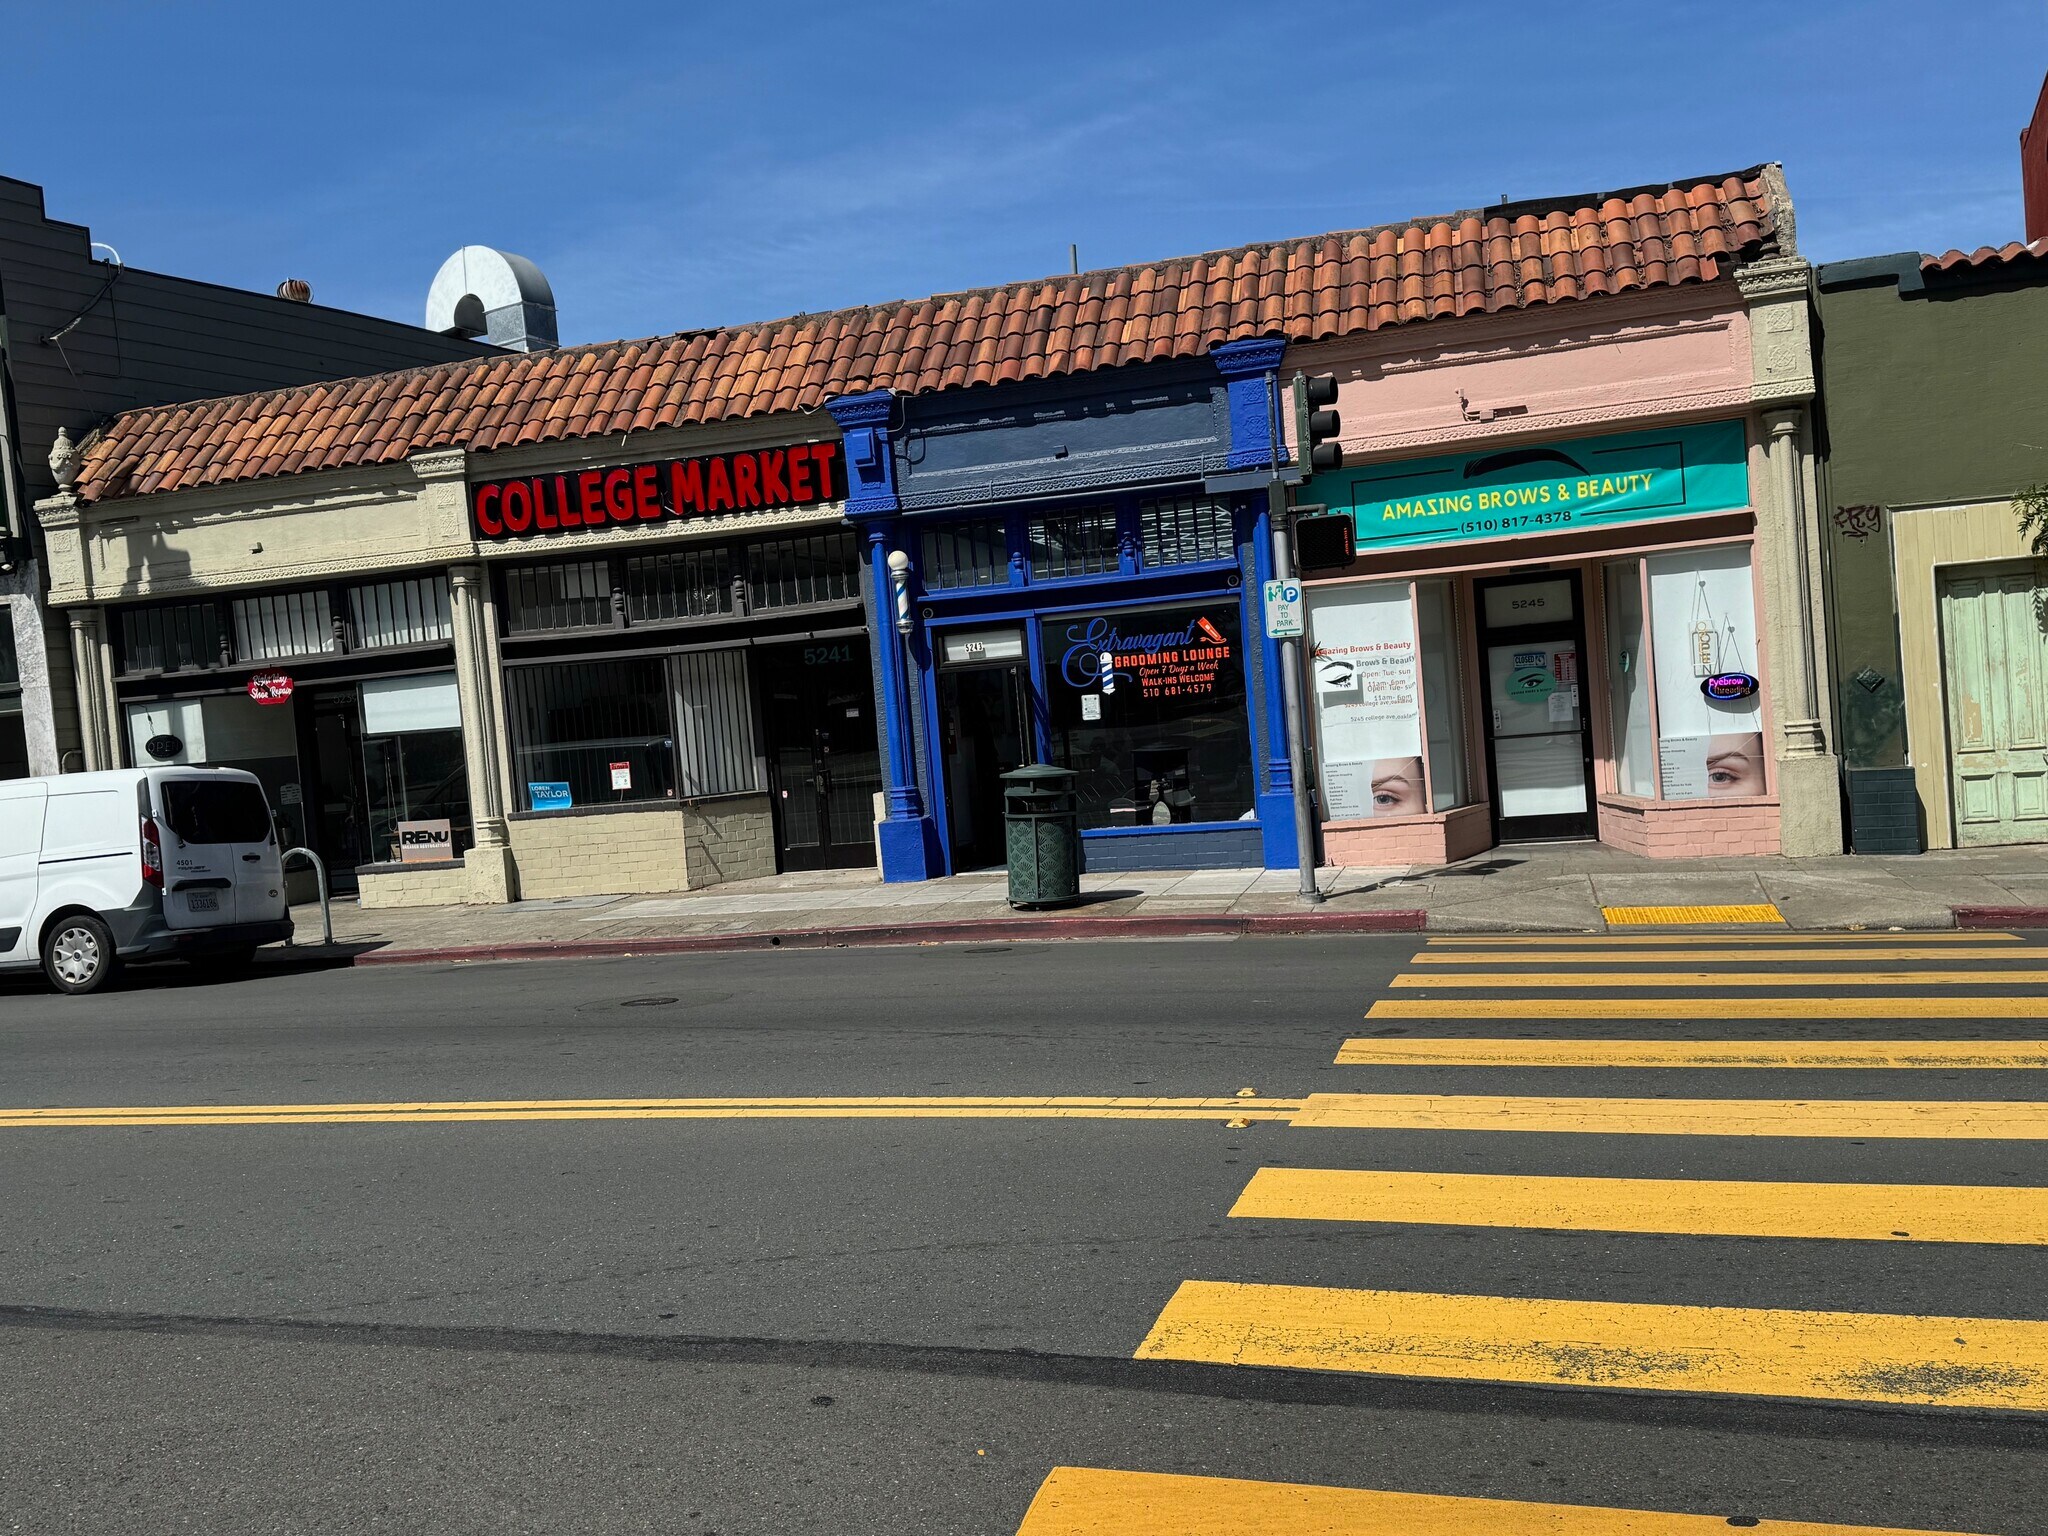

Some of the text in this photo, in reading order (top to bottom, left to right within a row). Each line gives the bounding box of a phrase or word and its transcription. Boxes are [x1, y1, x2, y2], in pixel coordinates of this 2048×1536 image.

[476, 443, 836, 535] COLLEGE MARKET
[1479, 485, 1551, 511] BROWS
[1557, 483, 1571, 501] &
[1577, 473, 1653, 499] BEAUTY
[1461, 510, 1572, 535] (510) 817-4378
[1277, 603, 1290, 612] PAY
[1512, 598, 1545, 610] 5245
[1276, 618, 1293, 627] PARK
[965, 642, 983, 652] 5243
[1061, 617, 1196, 688] Extravagant
[1350, 644, 1374, 653] Brows
[1375, 643, 1382, 651] &
[1383, 641, 1411, 650] Beauty
[804, 644, 854, 665] 5241
[1114, 646, 1230, 668] GROOMING LOUNGE
[1515, 655, 1535, 664] CLOSED
[1139, 667, 1160, 677] Open
[1162, 665, 1167, 674] 7
[1169, 663, 1188, 675] Days
[1197, 660, 1219, 671] Week
[1141, 672, 1215, 687] WALK-INS WELCOME
[1708, 678, 1744, 687] Eyebrow
[250, 686, 292, 699] Shoe Repair
[1143, 687, 1160, 698] 510
[1714, 686, 1751, 695] Threading
[535, 790, 569, 798] TAYLOR
[402, 830, 449, 844] RENU
